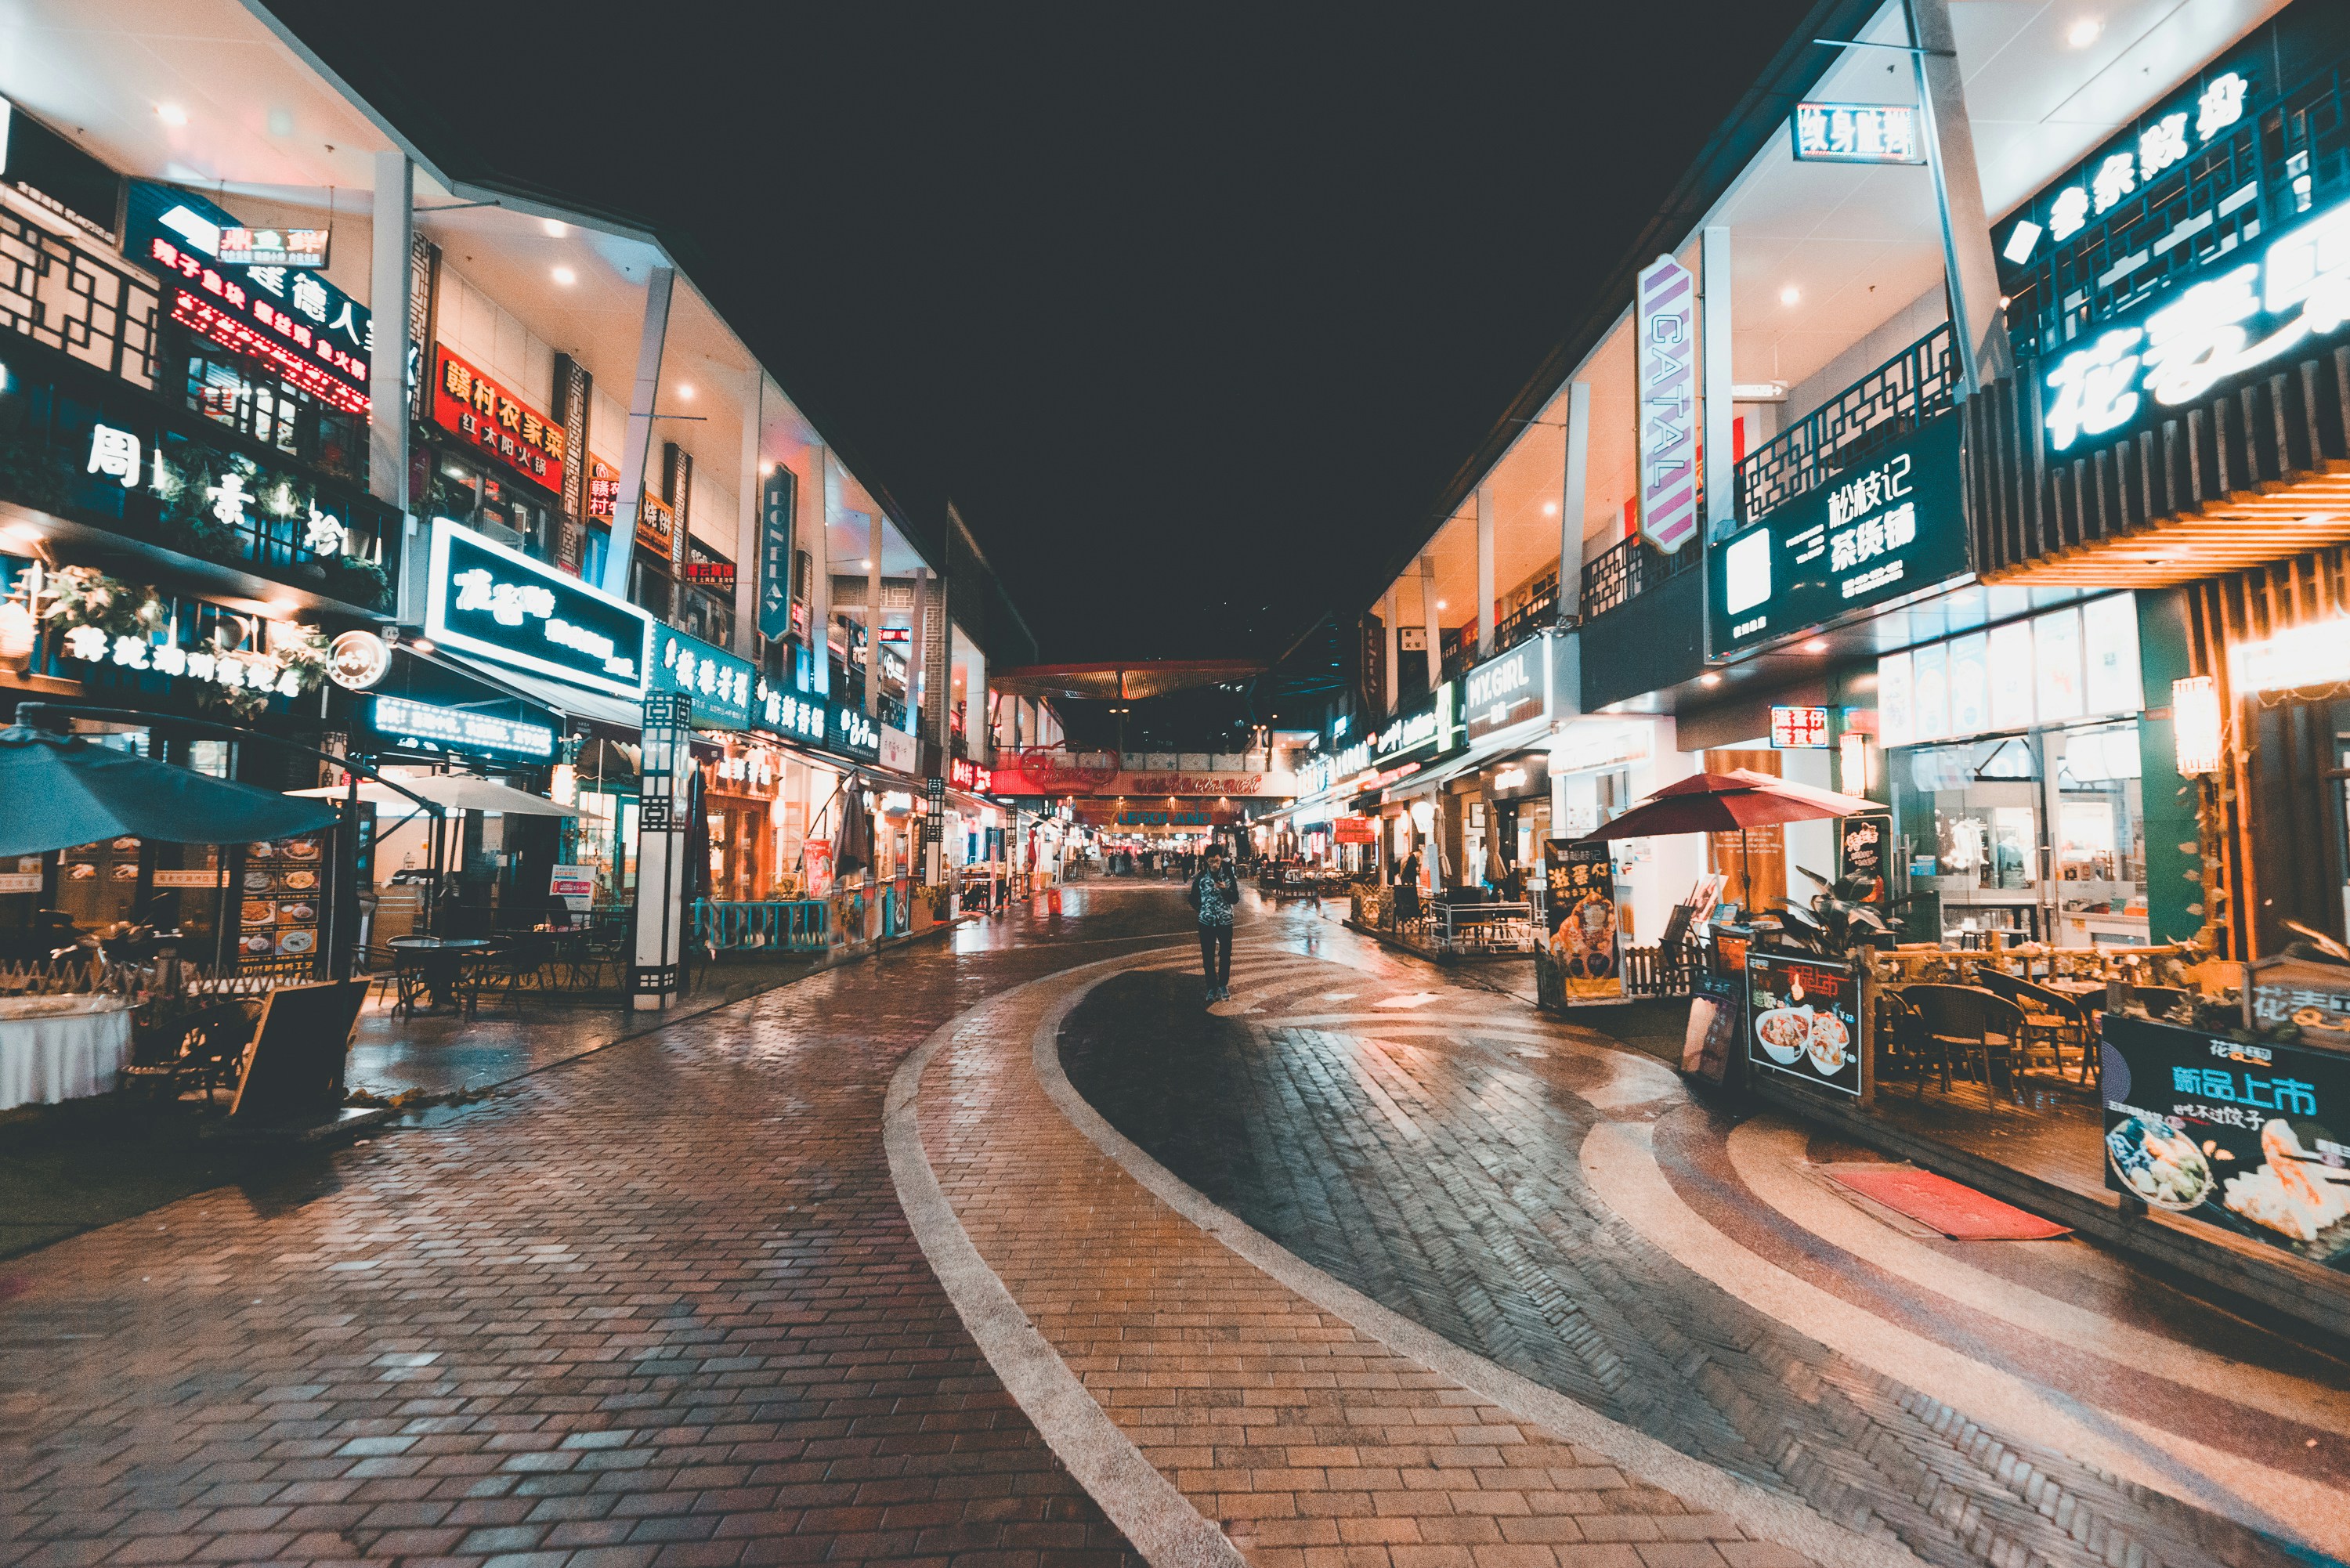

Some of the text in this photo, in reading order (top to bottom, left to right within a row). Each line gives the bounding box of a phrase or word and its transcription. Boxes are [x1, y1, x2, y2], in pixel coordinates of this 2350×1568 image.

[446, 359, 563, 461] 赣村农家菜
[1652, 314, 1685, 488] CATAL
[461, 412, 547, 476] 红太阳火锅
[1828, 453, 1913, 529] 松枝记
[1830, 502, 1917, 573] 茶货铺
[1774, 710, 1824, 728] 滋蛋仔
[1774, 728, 1825, 745] 茶货铺
[1117, 811, 1212, 824] LEGOLAND
[2171, 1065, 2317, 1117] 新品上市
